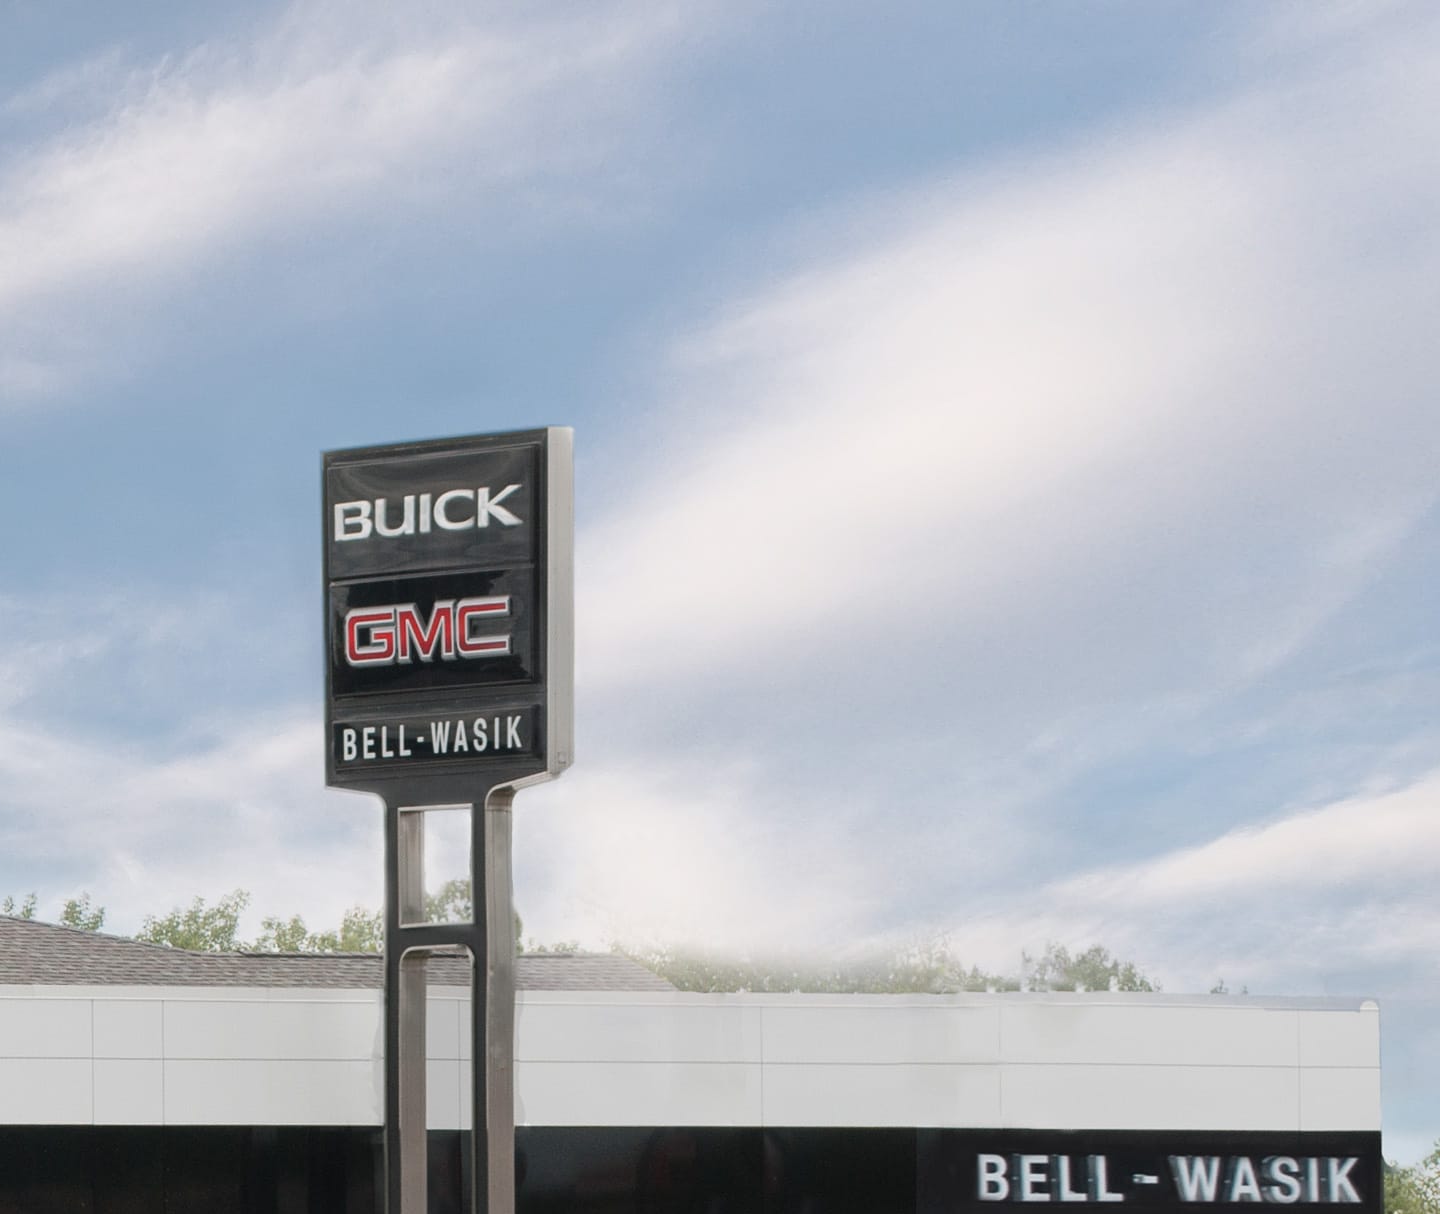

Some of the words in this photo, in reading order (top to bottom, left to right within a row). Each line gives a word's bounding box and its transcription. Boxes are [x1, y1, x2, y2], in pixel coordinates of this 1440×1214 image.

[333, 484, 524, 542] BUICK
[345, 595, 513, 668] GMC
[342, 715, 523, 761] BELL-WASIK
